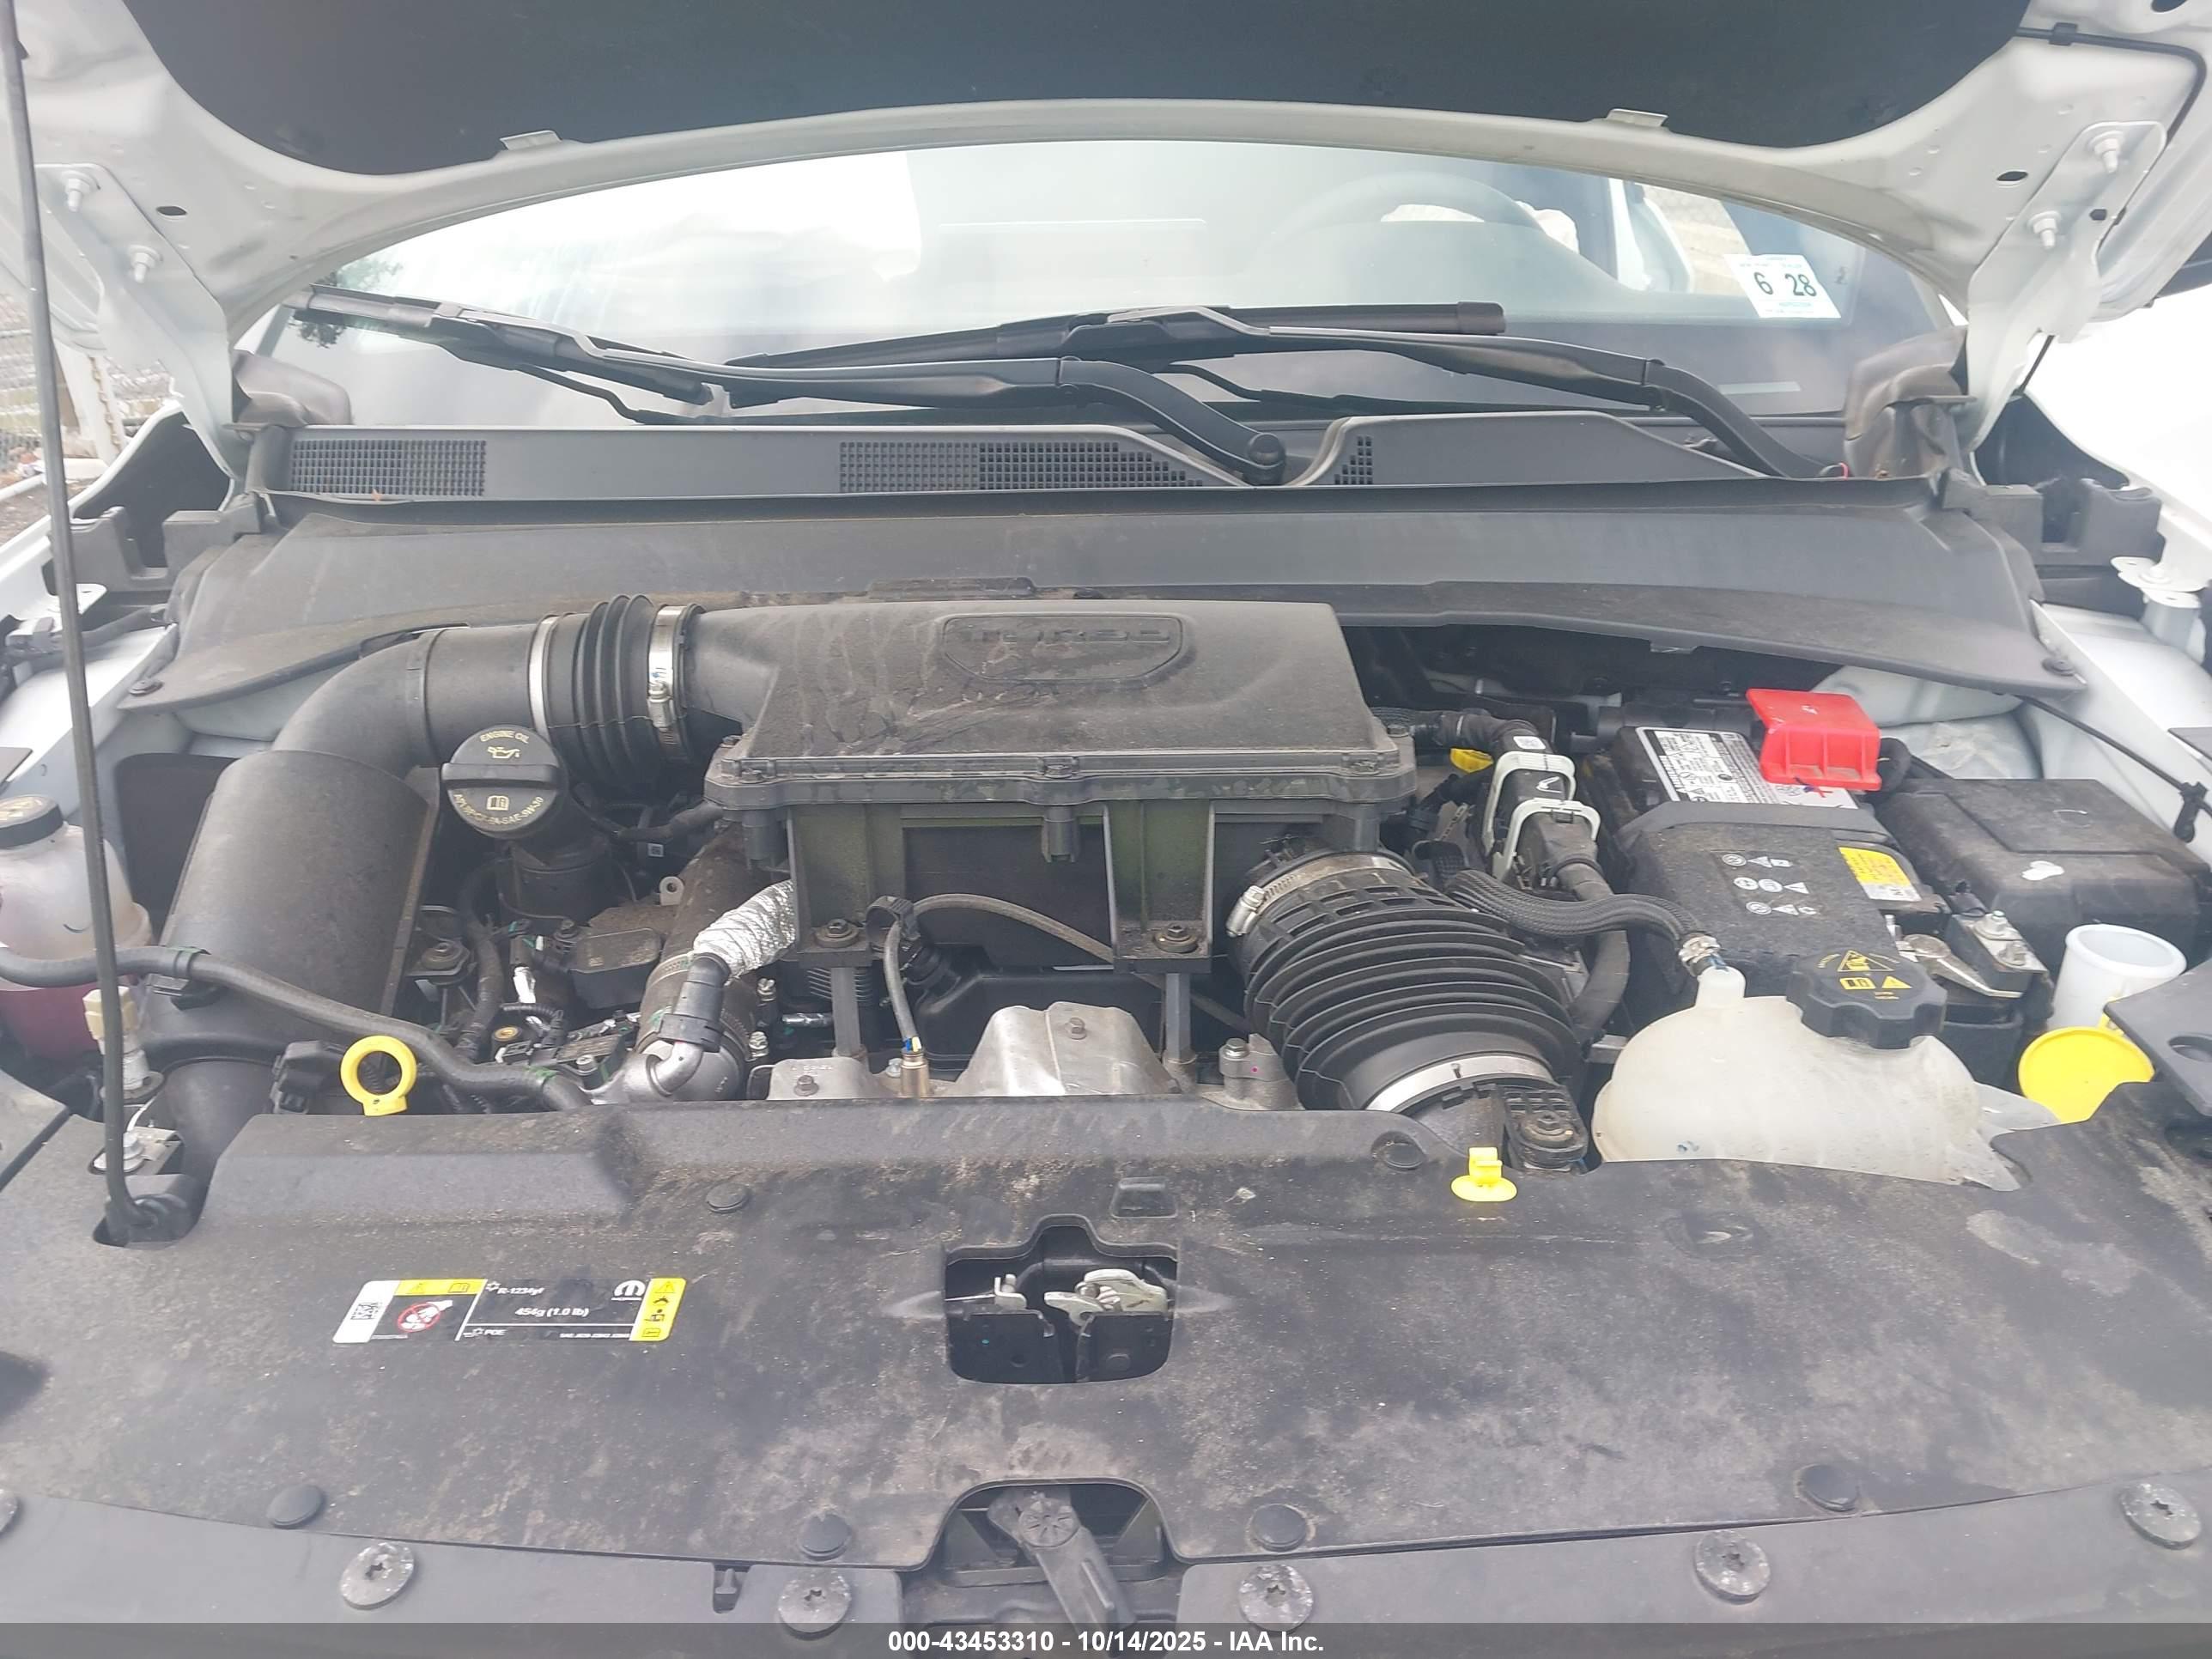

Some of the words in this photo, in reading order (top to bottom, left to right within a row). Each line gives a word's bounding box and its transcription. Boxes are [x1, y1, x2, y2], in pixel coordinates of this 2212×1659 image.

[1753, 271, 1773, 295] 6
[1784, 273, 1817, 296] 28
[480, 730, 514, 742] ENGINE
[515, 732, 531, 744] OIL
[515, 1308, 544, 1317] 454g
[547, 1308, 568, 1317] (1.0
